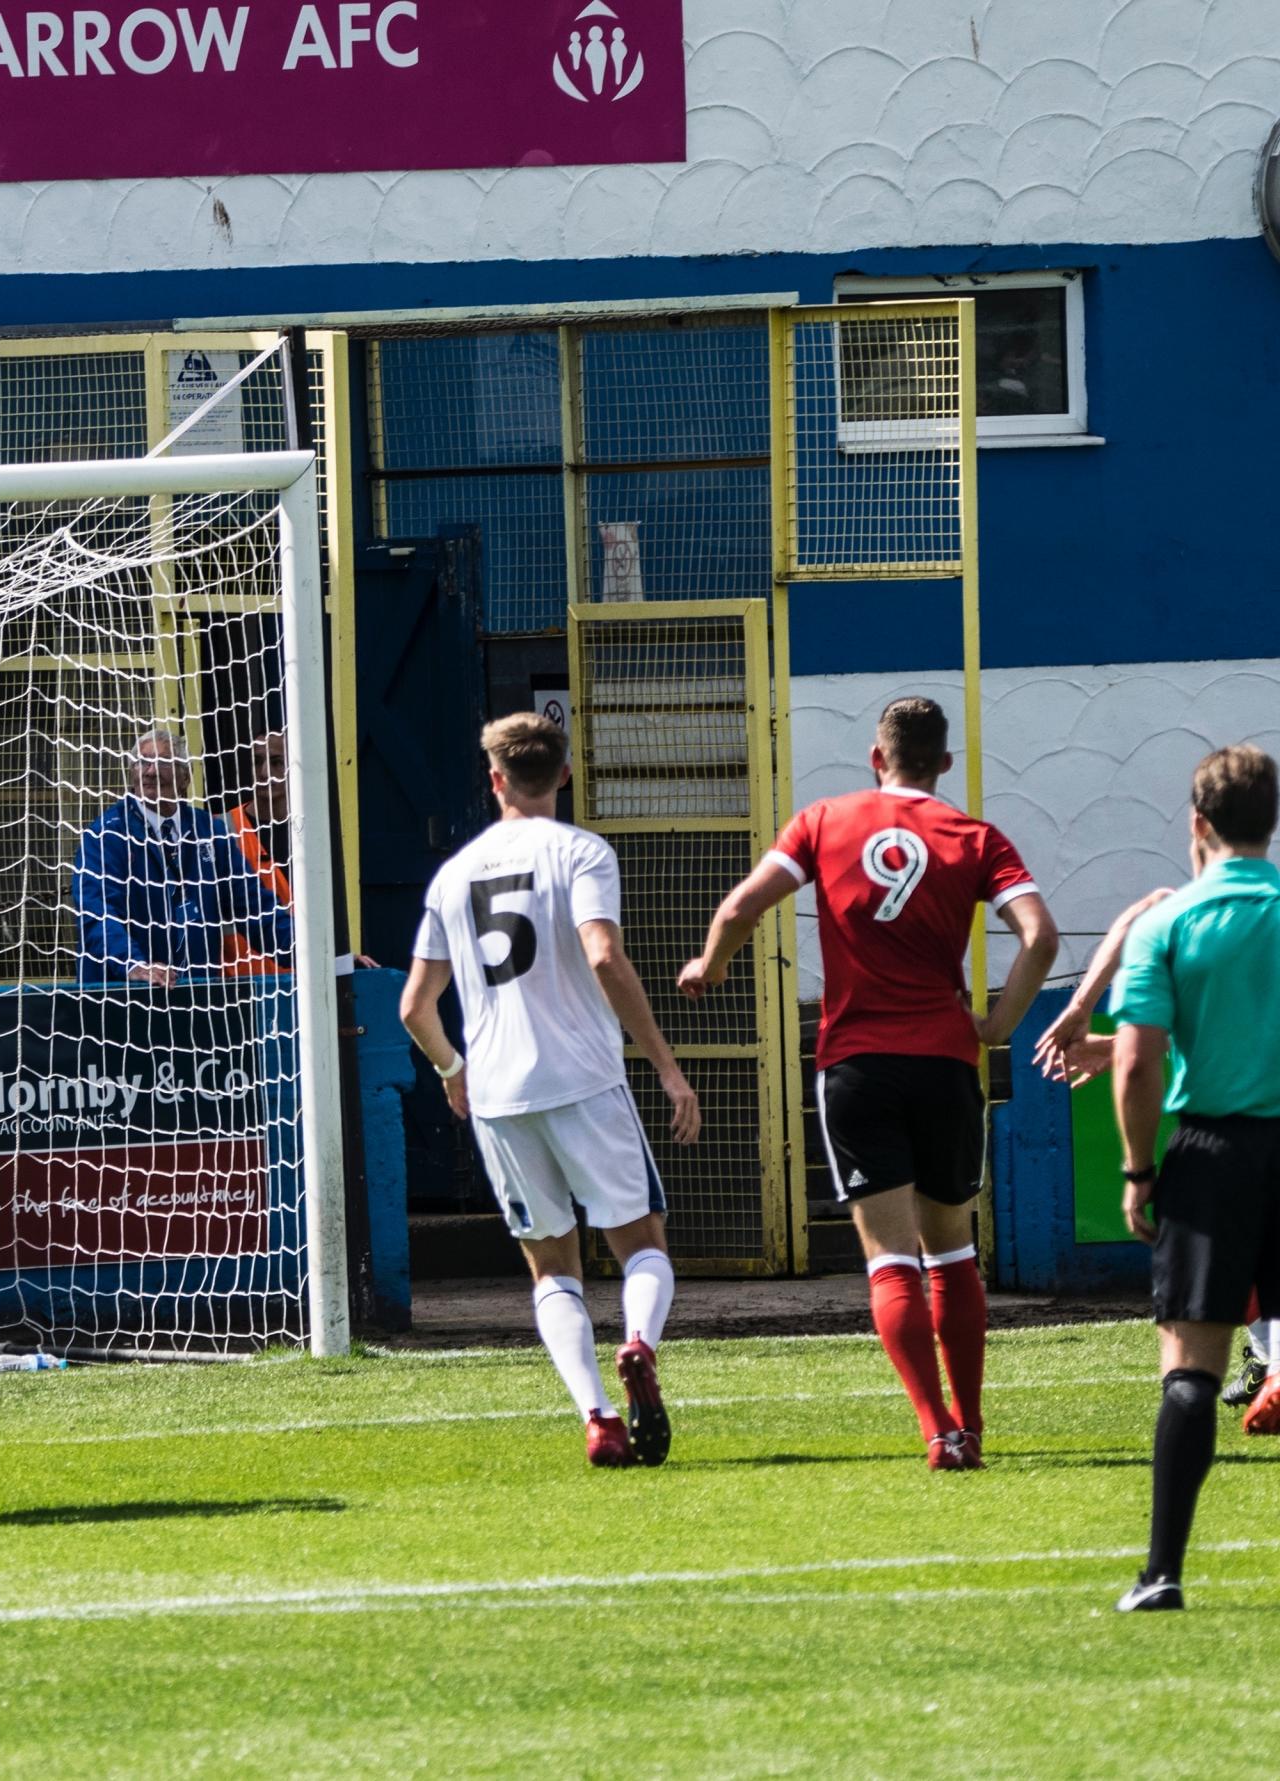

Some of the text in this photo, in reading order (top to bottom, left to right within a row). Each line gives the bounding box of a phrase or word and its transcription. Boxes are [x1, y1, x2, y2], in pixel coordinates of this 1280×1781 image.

[282, 1, 420, 71] AFC
[862, 827, 928, 921] 9
[470, 871, 538, 988] 5
[154, 1061, 186, 1104] &
[196, 1059, 250, 1101] Co
[0, 1113, 116, 1136] ACCOUNTANTS
[11, 1189, 49, 1217] the
[60, 1186, 100, 1218] face
[109, 1182, 133, 1209] of
[136, 1185, 256, 1209] accountancy
